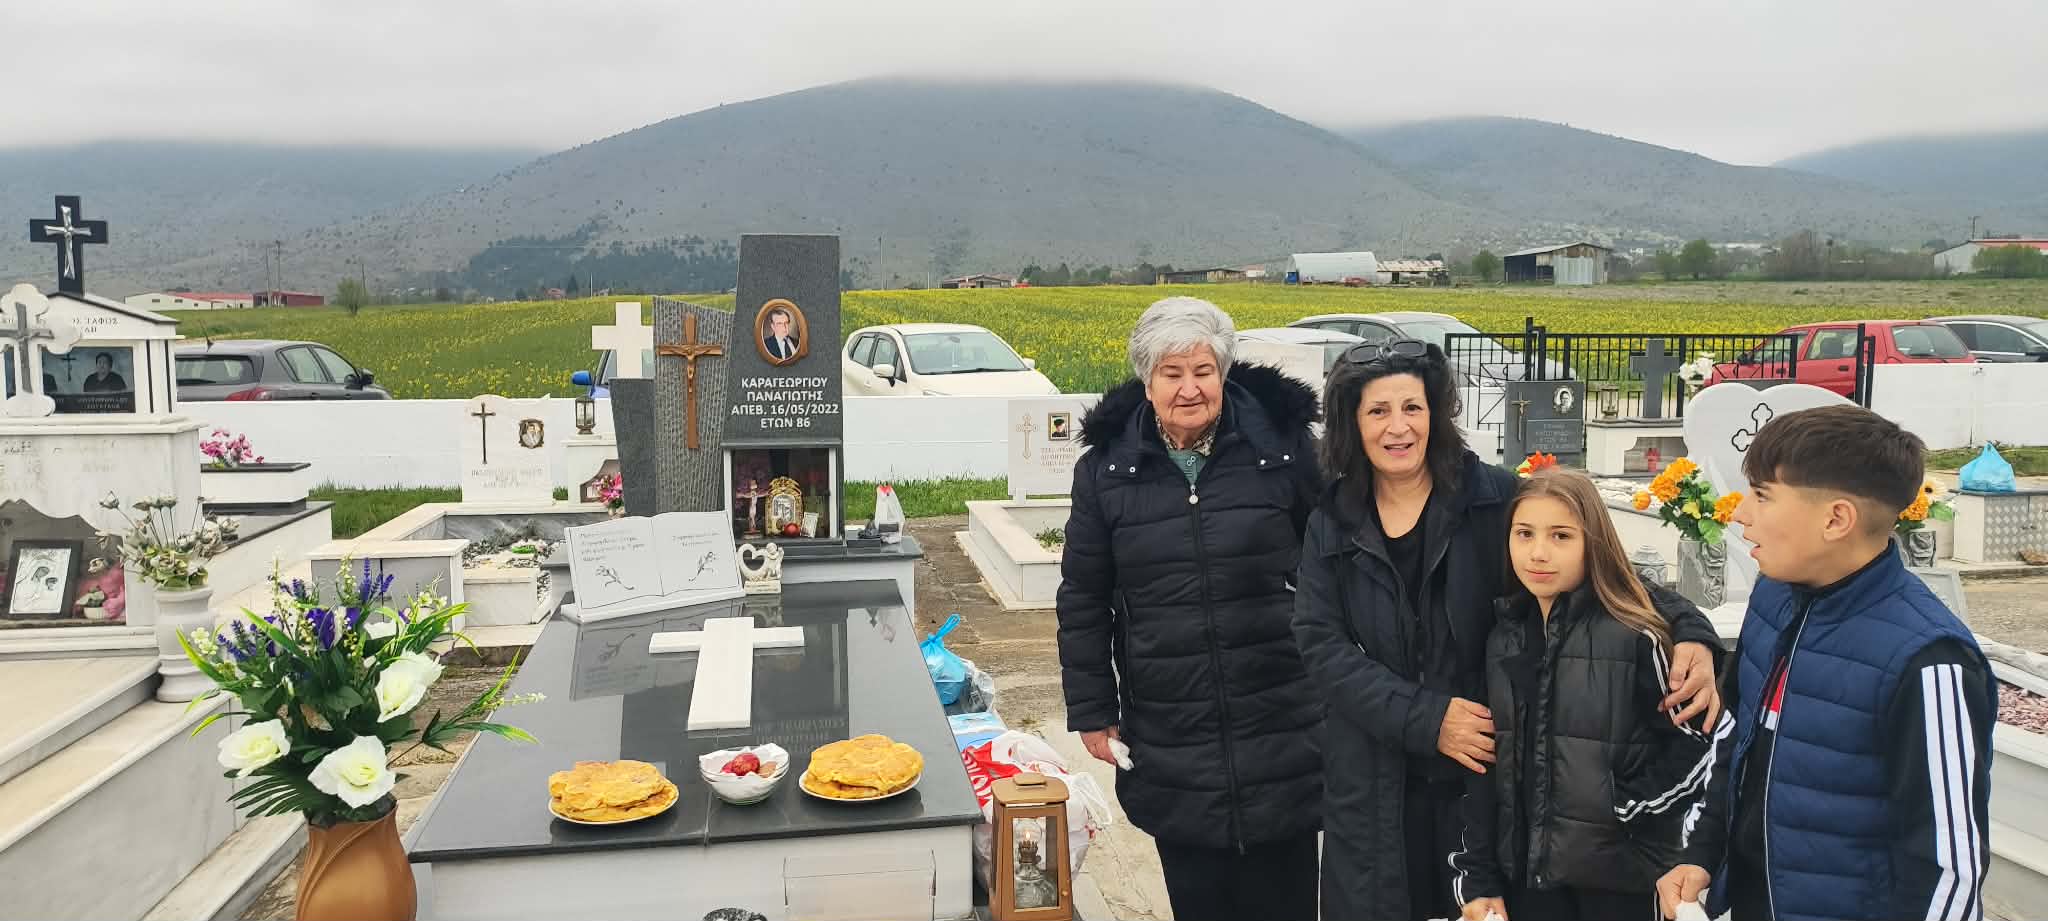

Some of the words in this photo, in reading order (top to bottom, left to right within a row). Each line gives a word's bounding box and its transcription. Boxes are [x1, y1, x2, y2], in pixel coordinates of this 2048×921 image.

[741, 377, 828, 388] ΚΑΡΑΓΕΩΡΓΙΟΥ
[746, 391, 824, 402] ΠΑΝΑΓΙΩΤΗΣ
[731, 404, 767, 416] ΑΠΕΒ.
[770, 403, 839, 416] 16/05/2022
[760, 418, 793, 429] ΕΤΩΝ
[796, 417, 811, 428] 86
